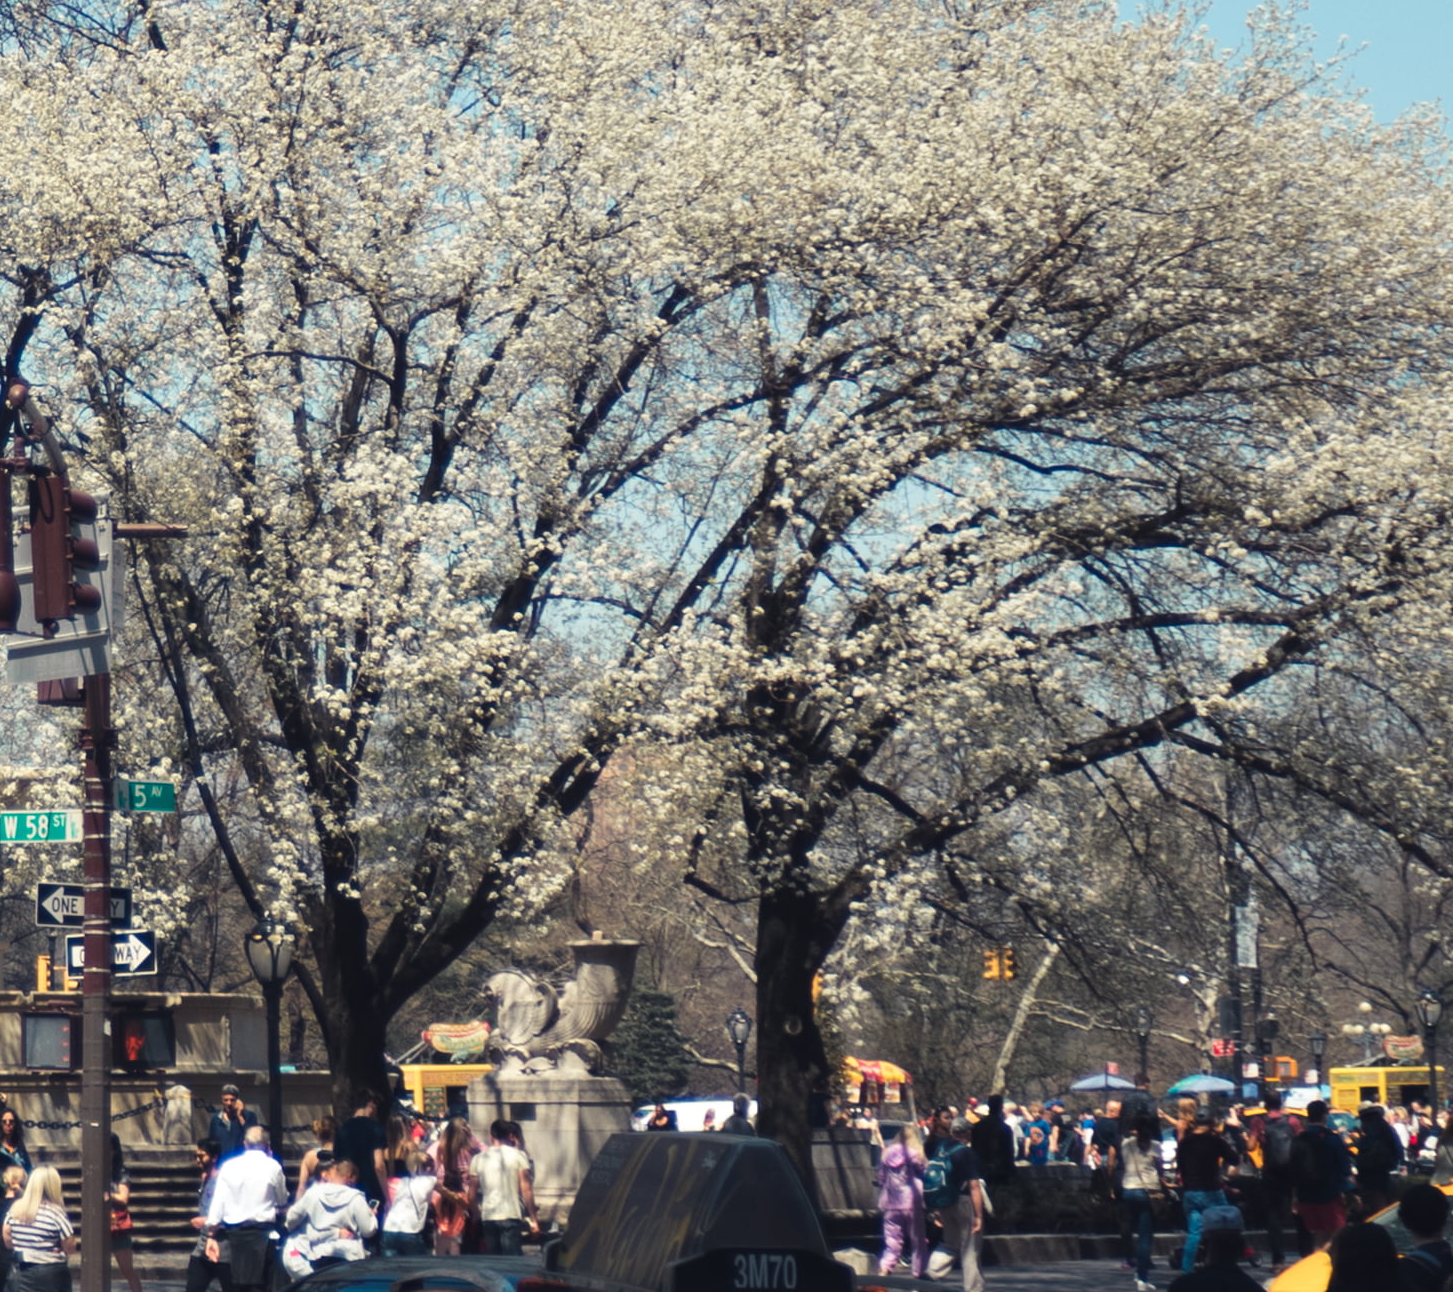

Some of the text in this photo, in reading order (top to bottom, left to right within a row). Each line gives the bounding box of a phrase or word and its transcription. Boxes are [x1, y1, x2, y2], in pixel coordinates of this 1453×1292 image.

[134, 785, 163, 808] 5 AV
[4, 814, 66, 839] W 58 ST
[51, 897, 78, 914] ONE
[115, 945, 141, 961] WAY
[733, 1253, 797, 1290] 3M70
